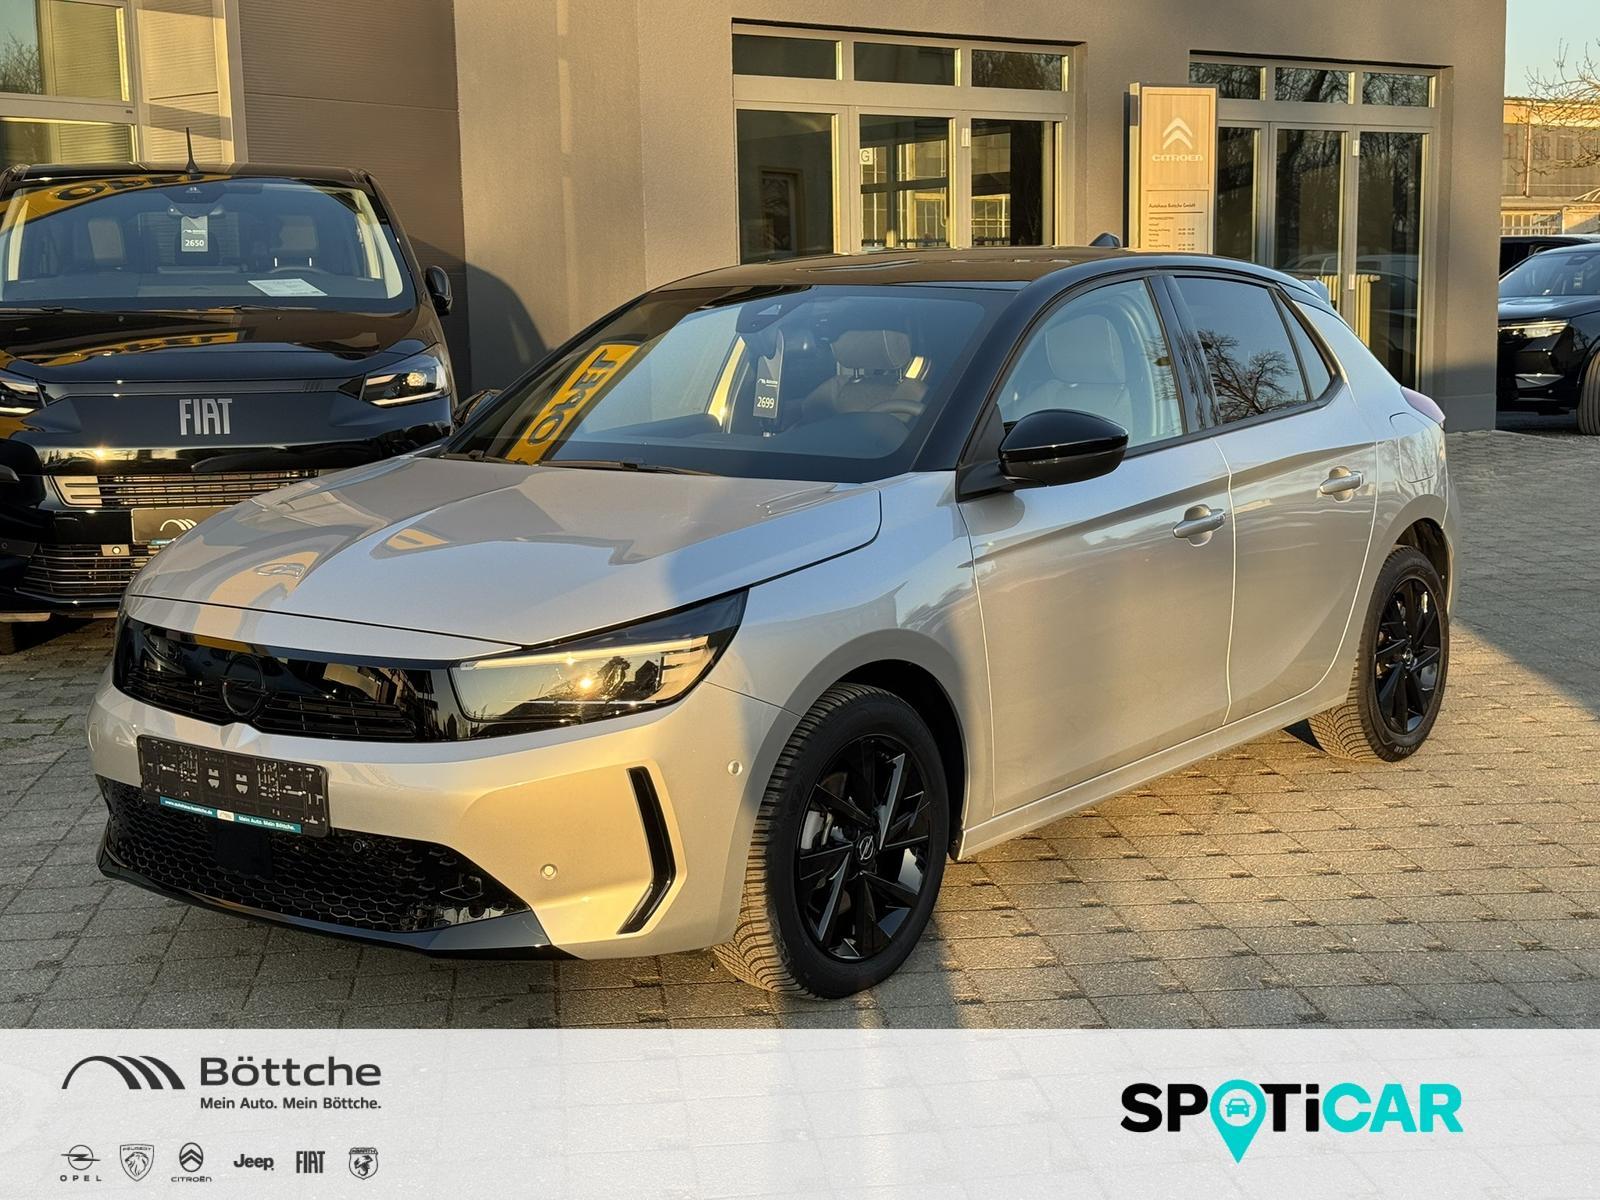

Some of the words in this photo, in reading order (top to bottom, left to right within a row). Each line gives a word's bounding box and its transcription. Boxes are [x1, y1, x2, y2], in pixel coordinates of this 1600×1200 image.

[861, 150, 870, 162] G
[184, 239, 205, 247] 2650
[757, 396, 775, 409] 2699
[179, 398, 232, 435] FIAT
